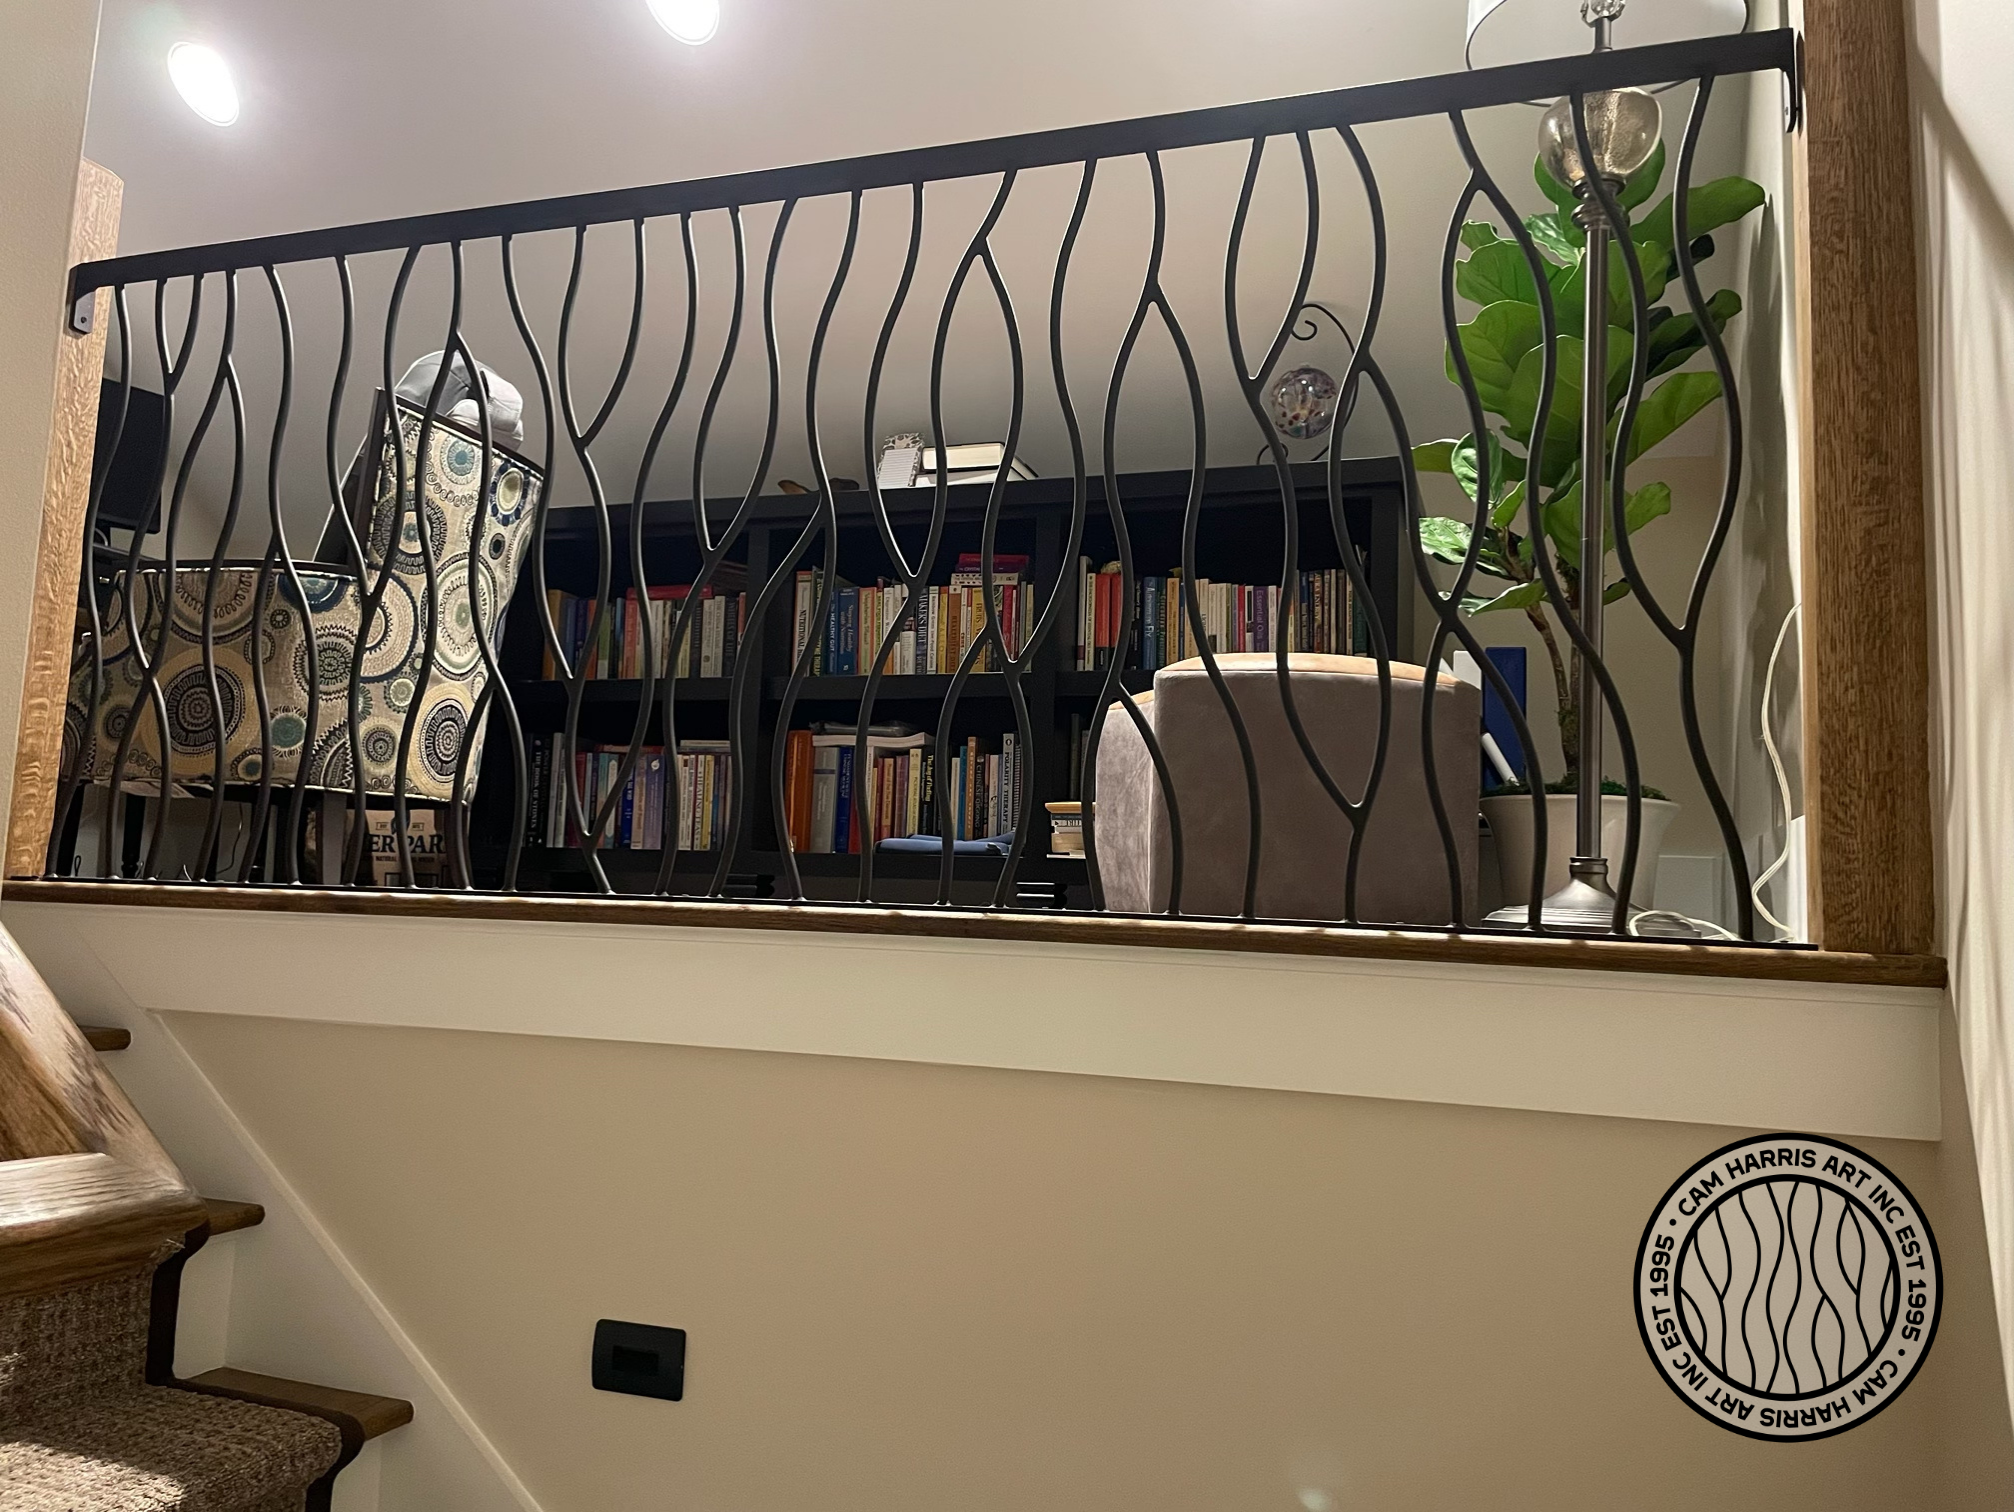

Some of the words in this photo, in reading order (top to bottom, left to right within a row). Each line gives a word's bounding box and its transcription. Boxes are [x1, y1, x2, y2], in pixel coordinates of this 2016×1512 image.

[1256, 590, 1264, 624] Essential
[798, 609, 806, 648] NUTRITIONAL
[845, 628, 853, 653] Healthy
[1145, 626, 1153, 638] Fix
[533, 767, 541, 788] BOOK
[532, 789, 539, 799] OF
[695, 776, 703, 814] HEALING
[530, 800, 538, 829] STONES
